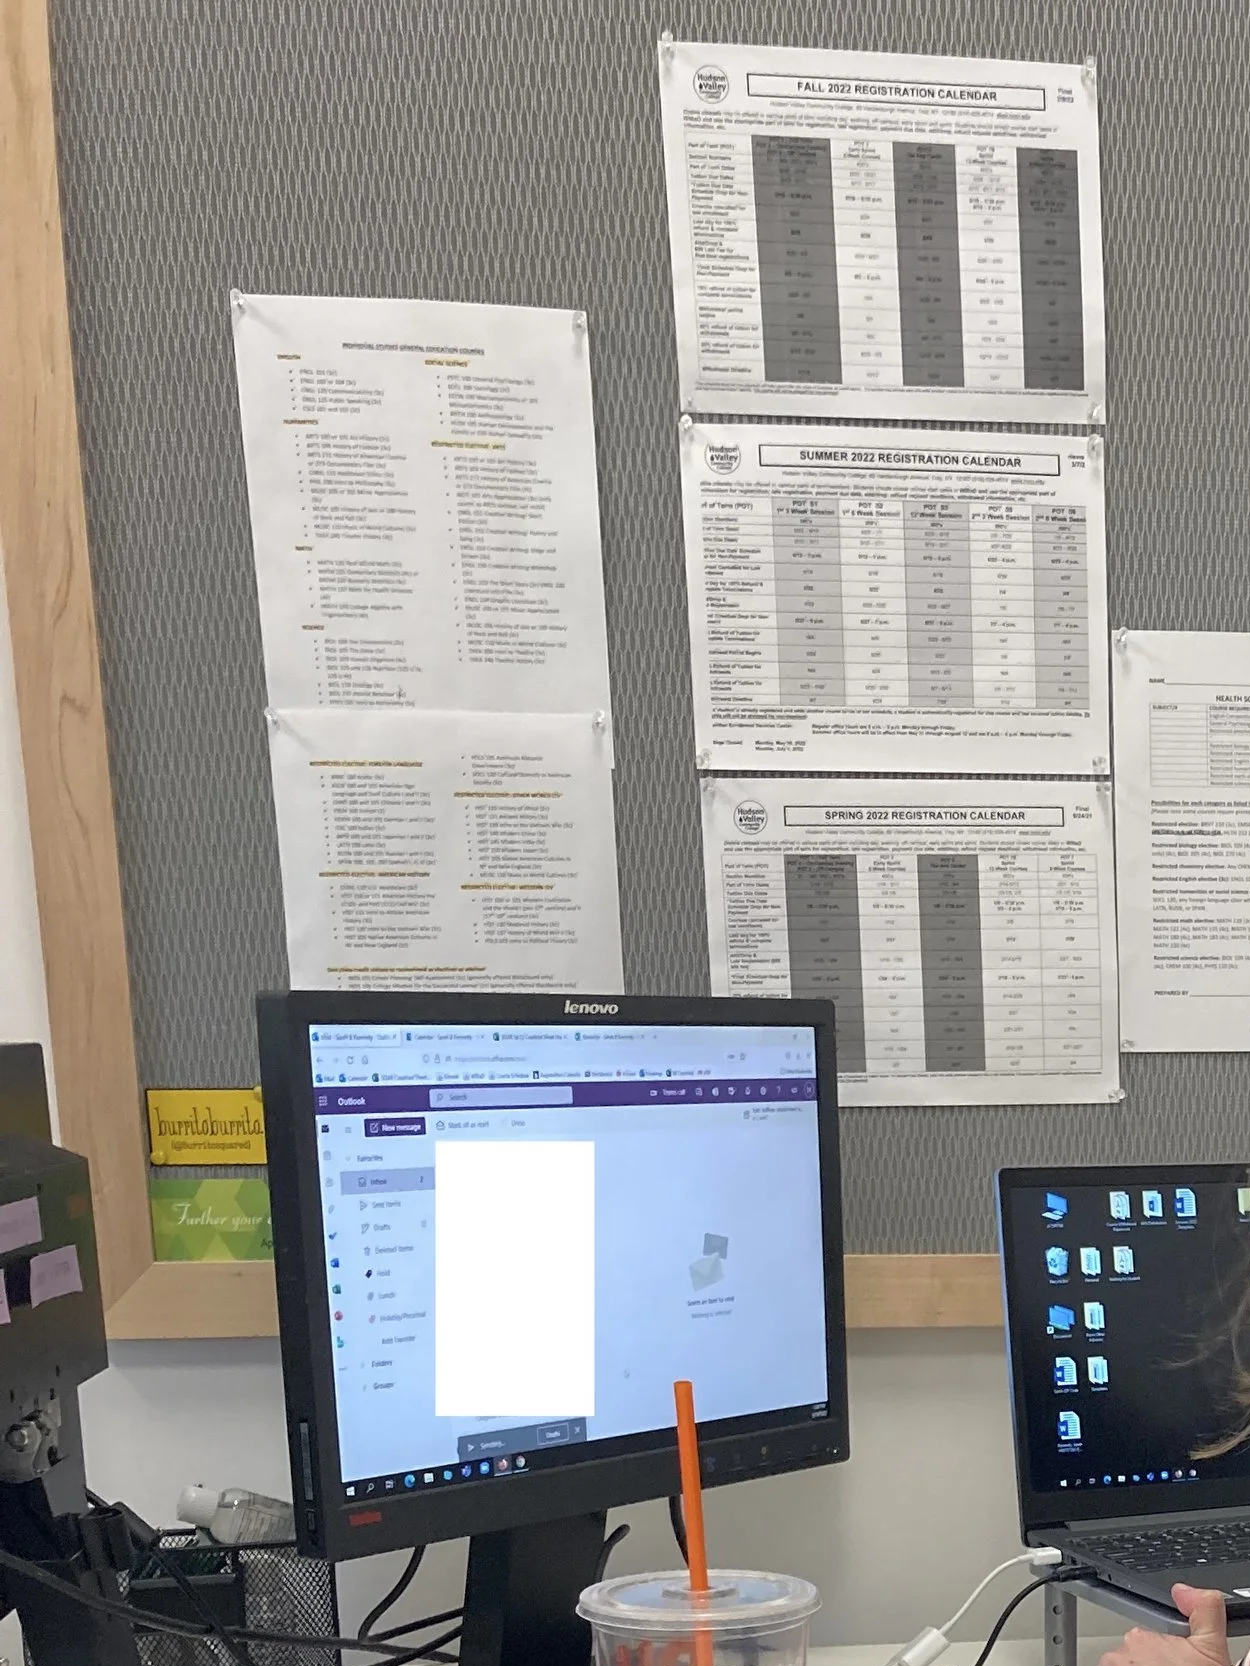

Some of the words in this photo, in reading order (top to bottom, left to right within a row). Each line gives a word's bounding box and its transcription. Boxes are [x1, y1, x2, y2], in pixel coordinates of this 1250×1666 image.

[703, 82, 727, 93] Valley
[797, 81, 824, 93] FALL
[828, 83, 852, 94] 2022
[854, 84, 935, 98] REGISTRATION
[937, 88, 997, 101] CALENDAR
[714, 453, 738, 463] Valley
[799, 450, 848, 461] SUMMER
[851, 451, 876, 463] 2022
[878, 453, 959, 466] REGISTRATION
[962, 456, 1022, 468] CALENDAR
[1216, 695, 1243, 704] HEALTH
[737, 808, 765, 816] Hudson
[825, 811, 864, 820] SPRING
[866, 811, 889, 820] 2022
[891, 811, 967, 821] REGISTRATION
[970, 811, 1026, 821] CALENDAR
[743, 815, 765, 824] Valley
[564, 1000, 619, 1016] lenovo
[338, 1096, 366, 1107] Outlook
[382, 1122, 395, 1133] New
[396, 1123, 422, 1134] message
[172, 1202, 227, 1226] Further
[232, 1216, 263, 1232] your
